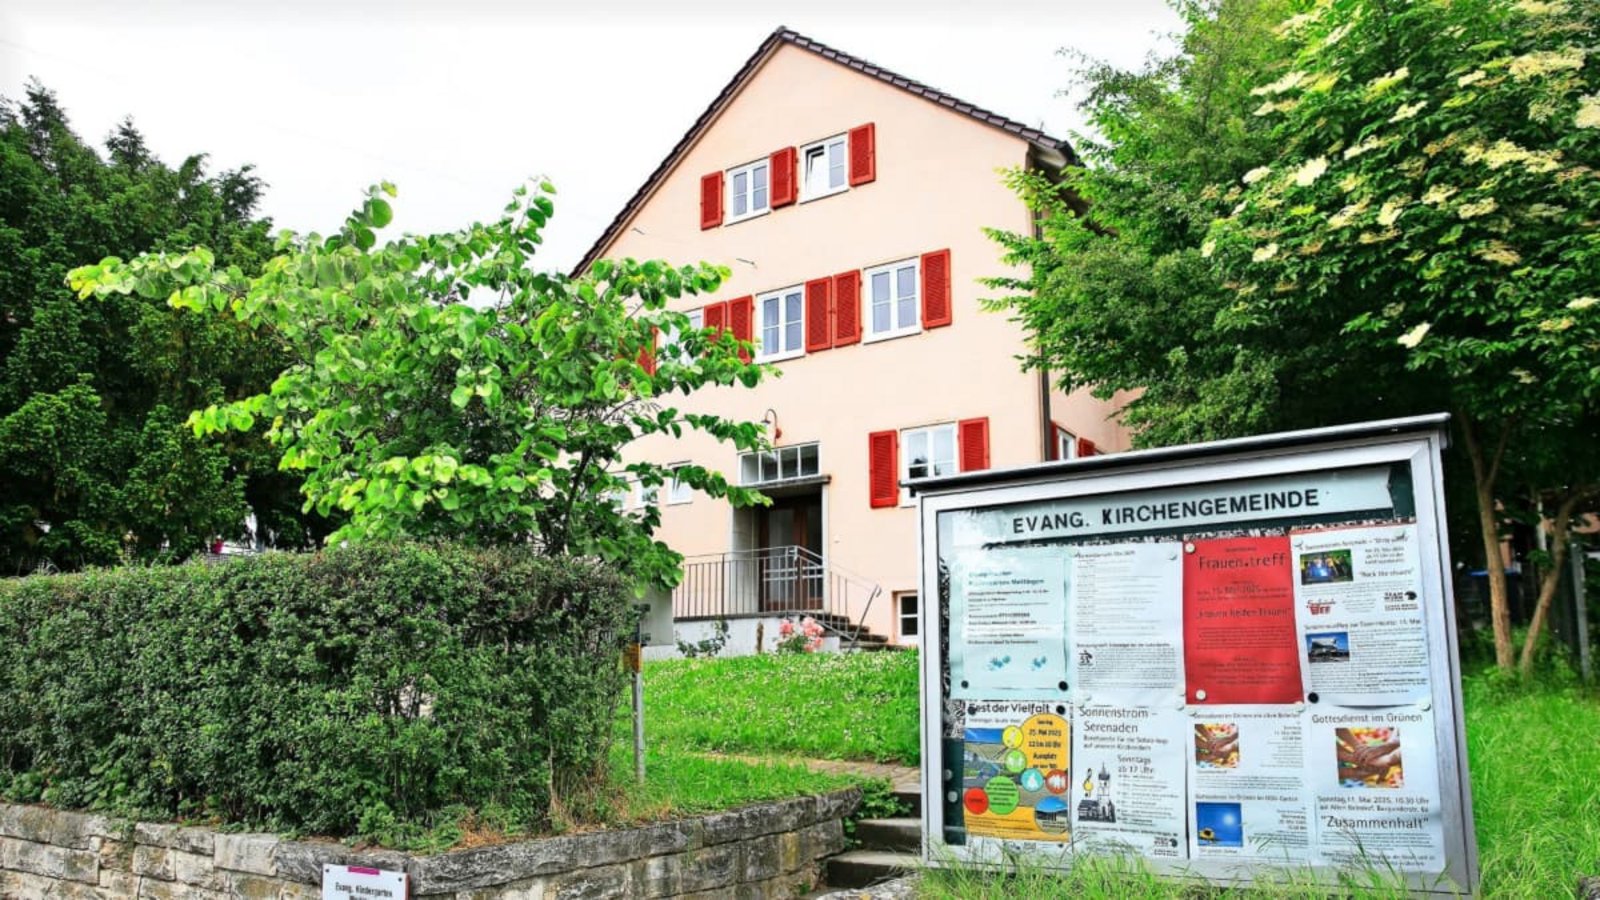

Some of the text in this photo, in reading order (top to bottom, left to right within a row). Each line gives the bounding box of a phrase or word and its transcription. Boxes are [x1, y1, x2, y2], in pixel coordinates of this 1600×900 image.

[1013, 488, 1320, 534] EVANG. KIRCHENGEMEINDE
[1199, 552, 1286, 571] Frauen.treff
[992, 703, 1009, 713] der
[1010, 702, 1050, 715] Vielfalt
[1079, 705, 1149, 718] Sonnenstrom
[1311, 714, 1368, 724] Gottesdienst
[1372, 713, 1383, 722] im
[1386, 711, 1422, 722] Grünen
[1083, 720, 1138, 733] Serenaden
